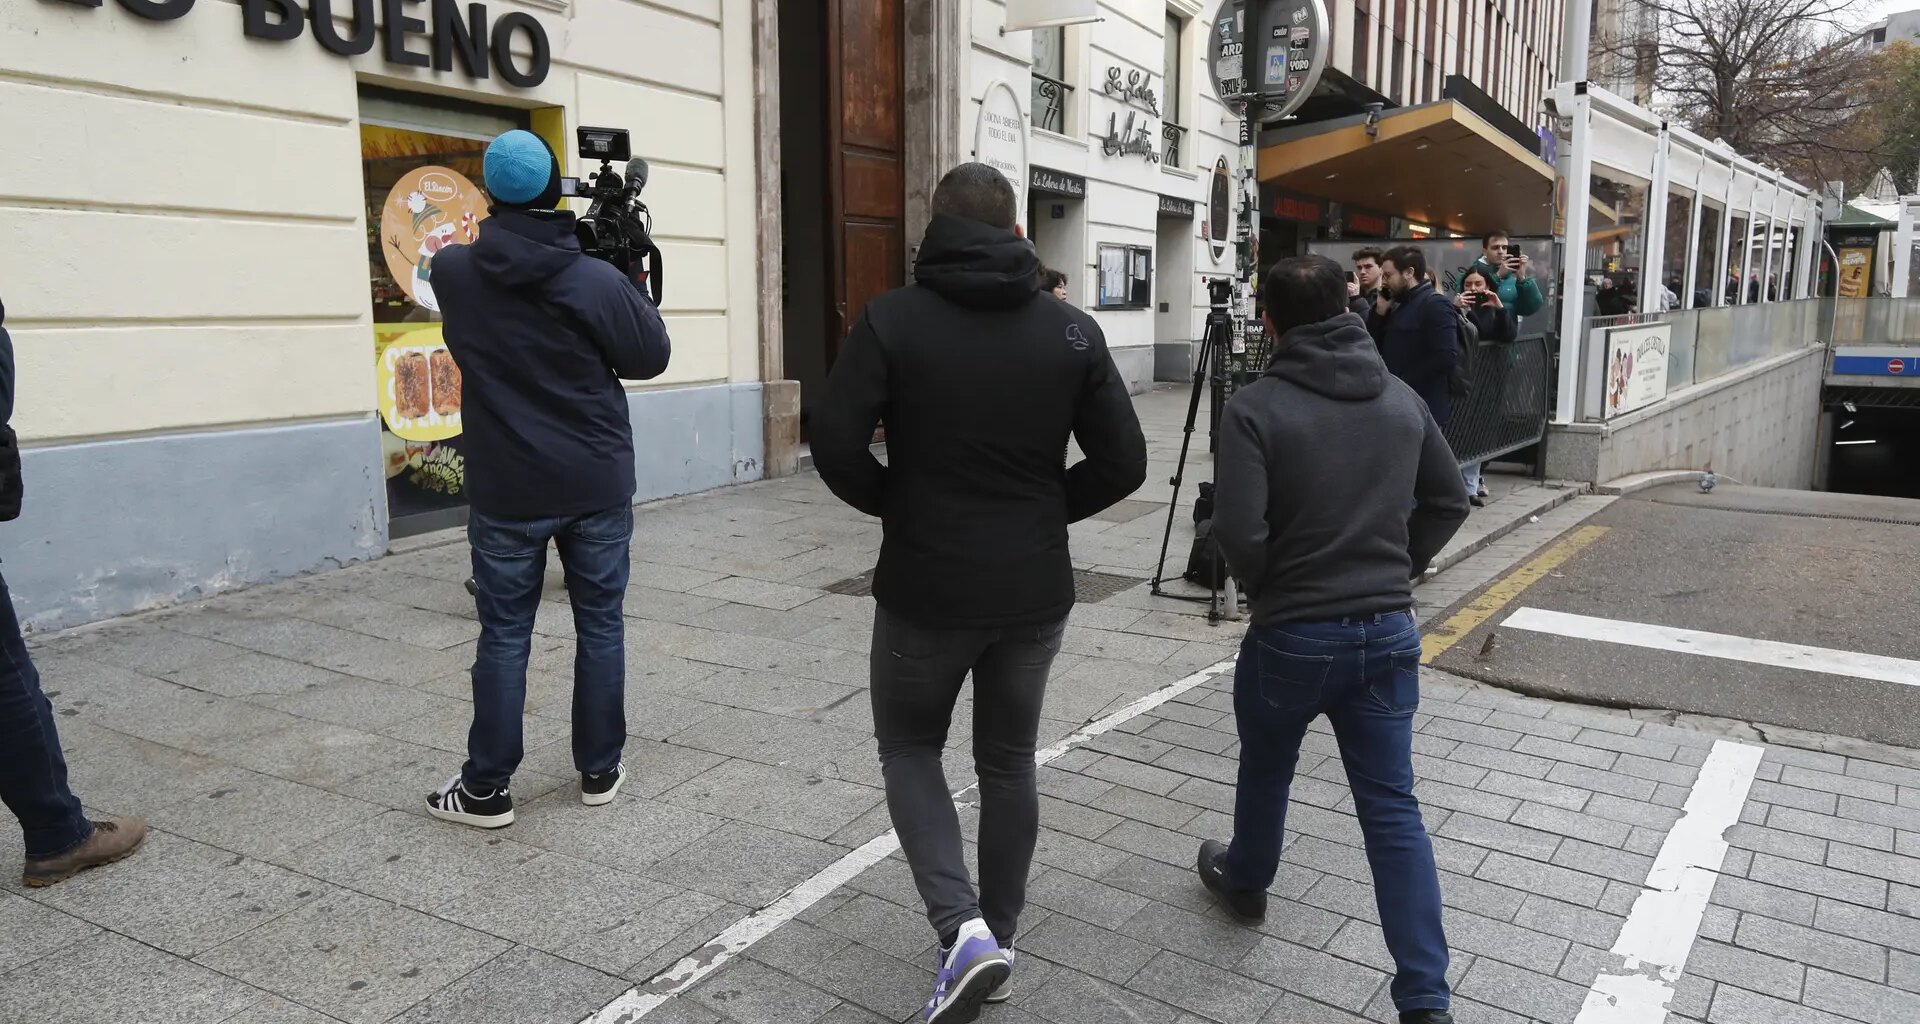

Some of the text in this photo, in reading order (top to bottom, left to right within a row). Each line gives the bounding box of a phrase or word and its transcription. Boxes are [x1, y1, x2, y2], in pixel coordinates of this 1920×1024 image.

[242, 0, 551, 88] BUENO
[1033, 171, 1041, 186] La
[1059, 178, 1065, 191] de
